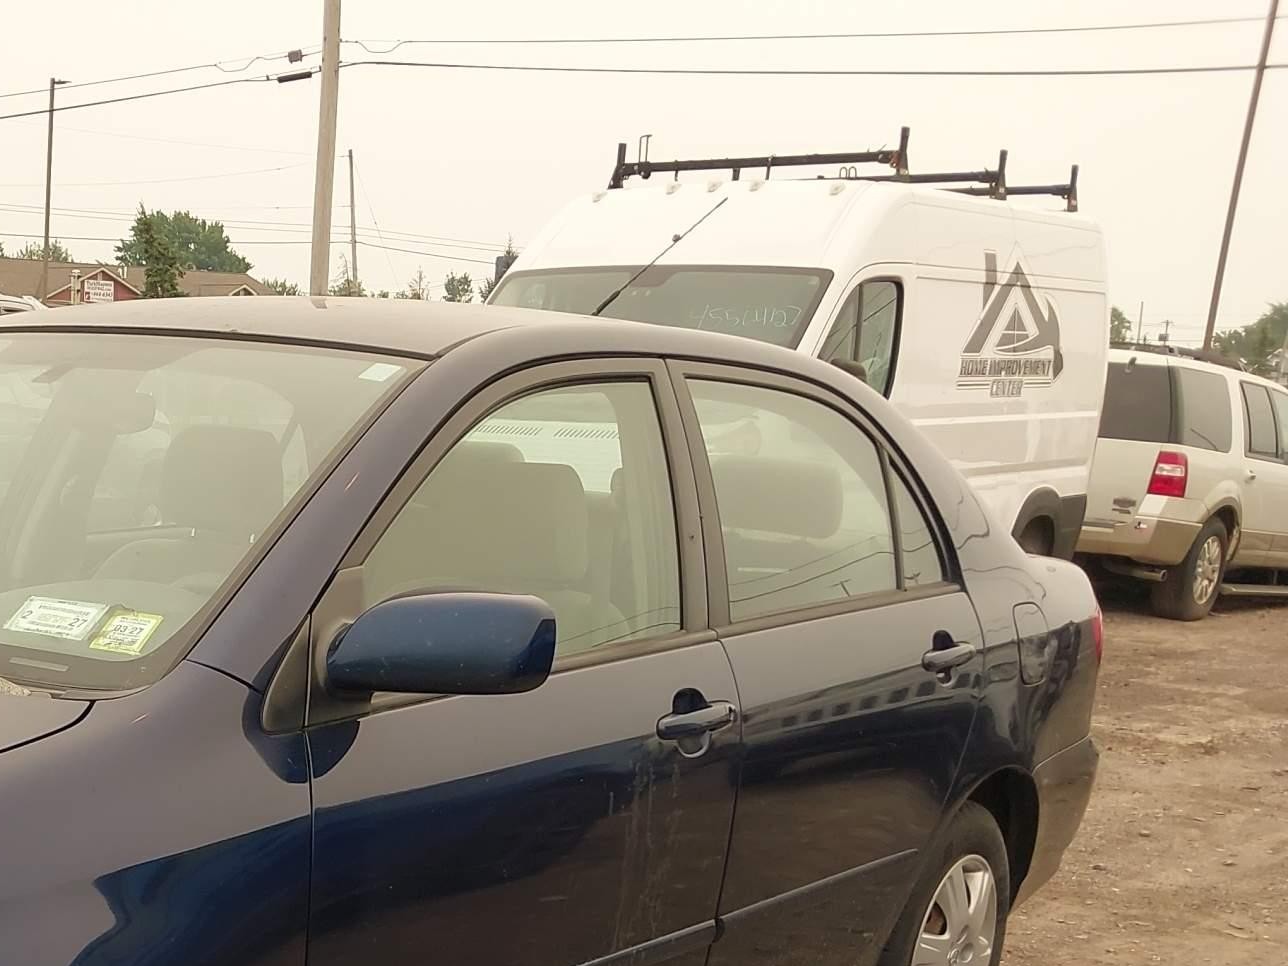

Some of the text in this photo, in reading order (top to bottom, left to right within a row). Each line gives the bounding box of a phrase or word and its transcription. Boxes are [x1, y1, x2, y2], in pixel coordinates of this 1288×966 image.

[959, 359, 1051, 377] HOME IMPROVEMENT
[990, 379, 1024, 397] CENTER
